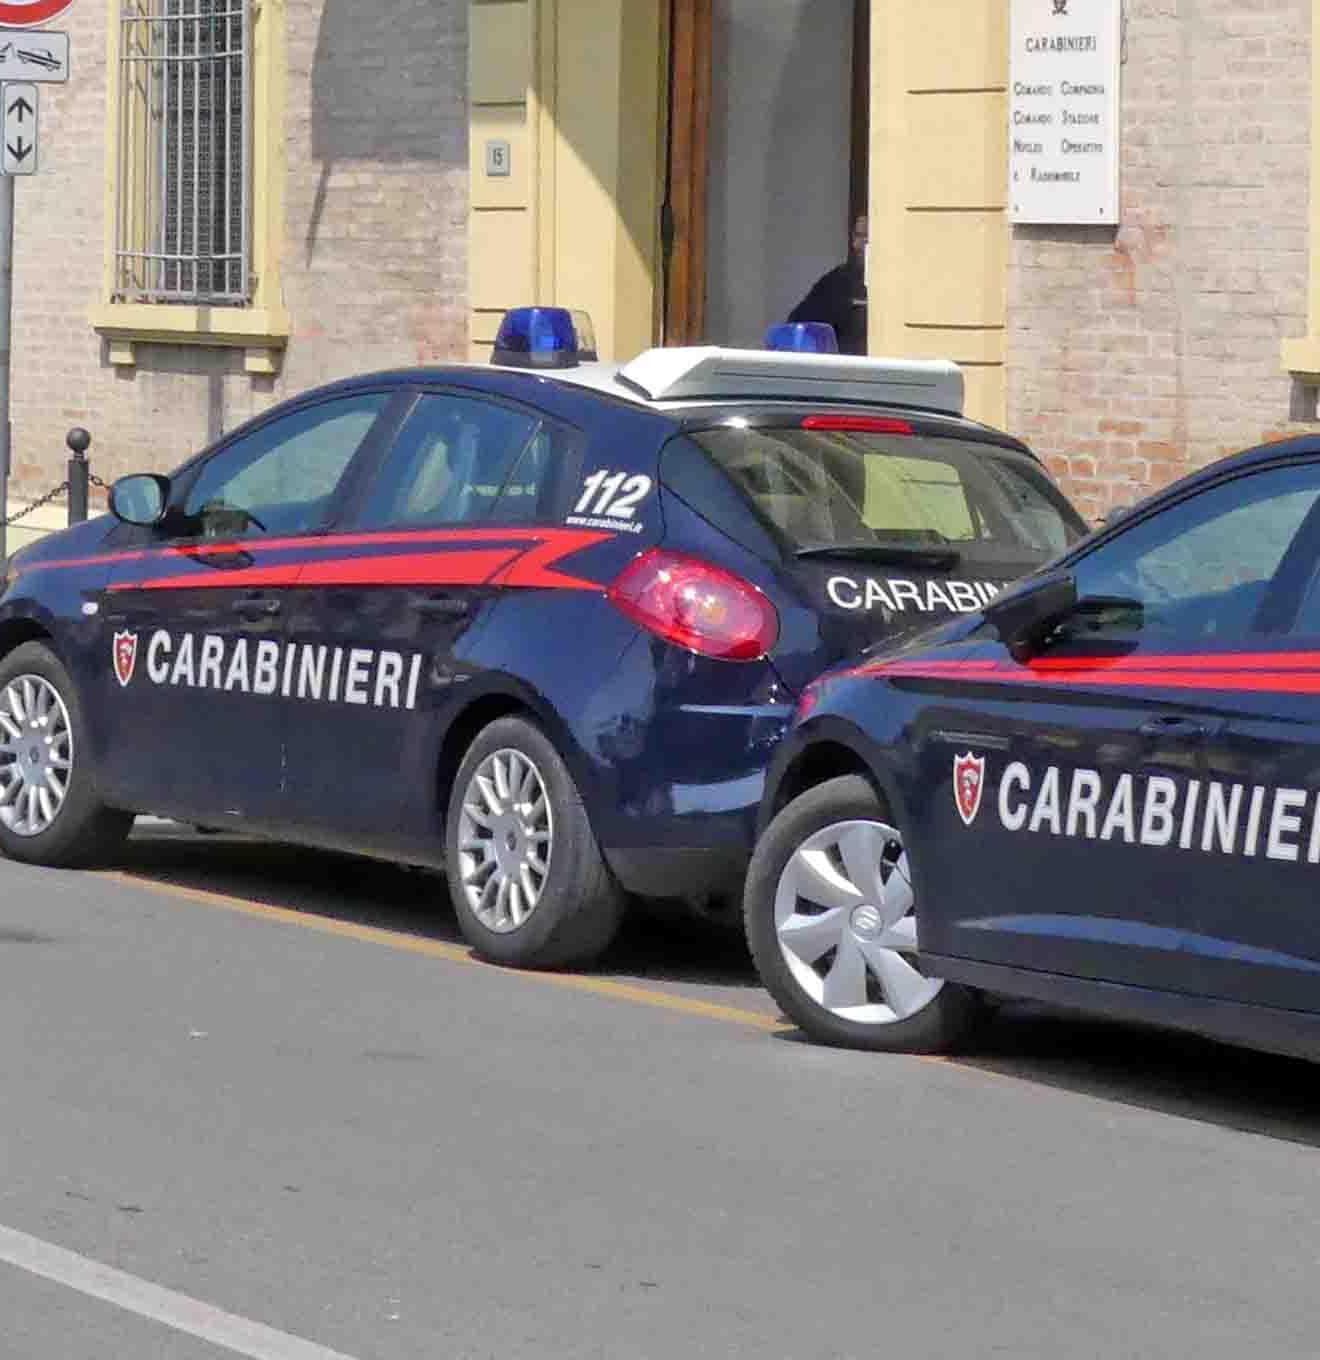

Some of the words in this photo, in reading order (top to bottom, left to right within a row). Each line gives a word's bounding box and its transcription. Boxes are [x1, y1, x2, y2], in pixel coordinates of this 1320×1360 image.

[1025, 36, 1097, 53] CARABINIERI
[574, 469, 652, 518] 112
[147, 629, 422, 709] CARABINIERI
